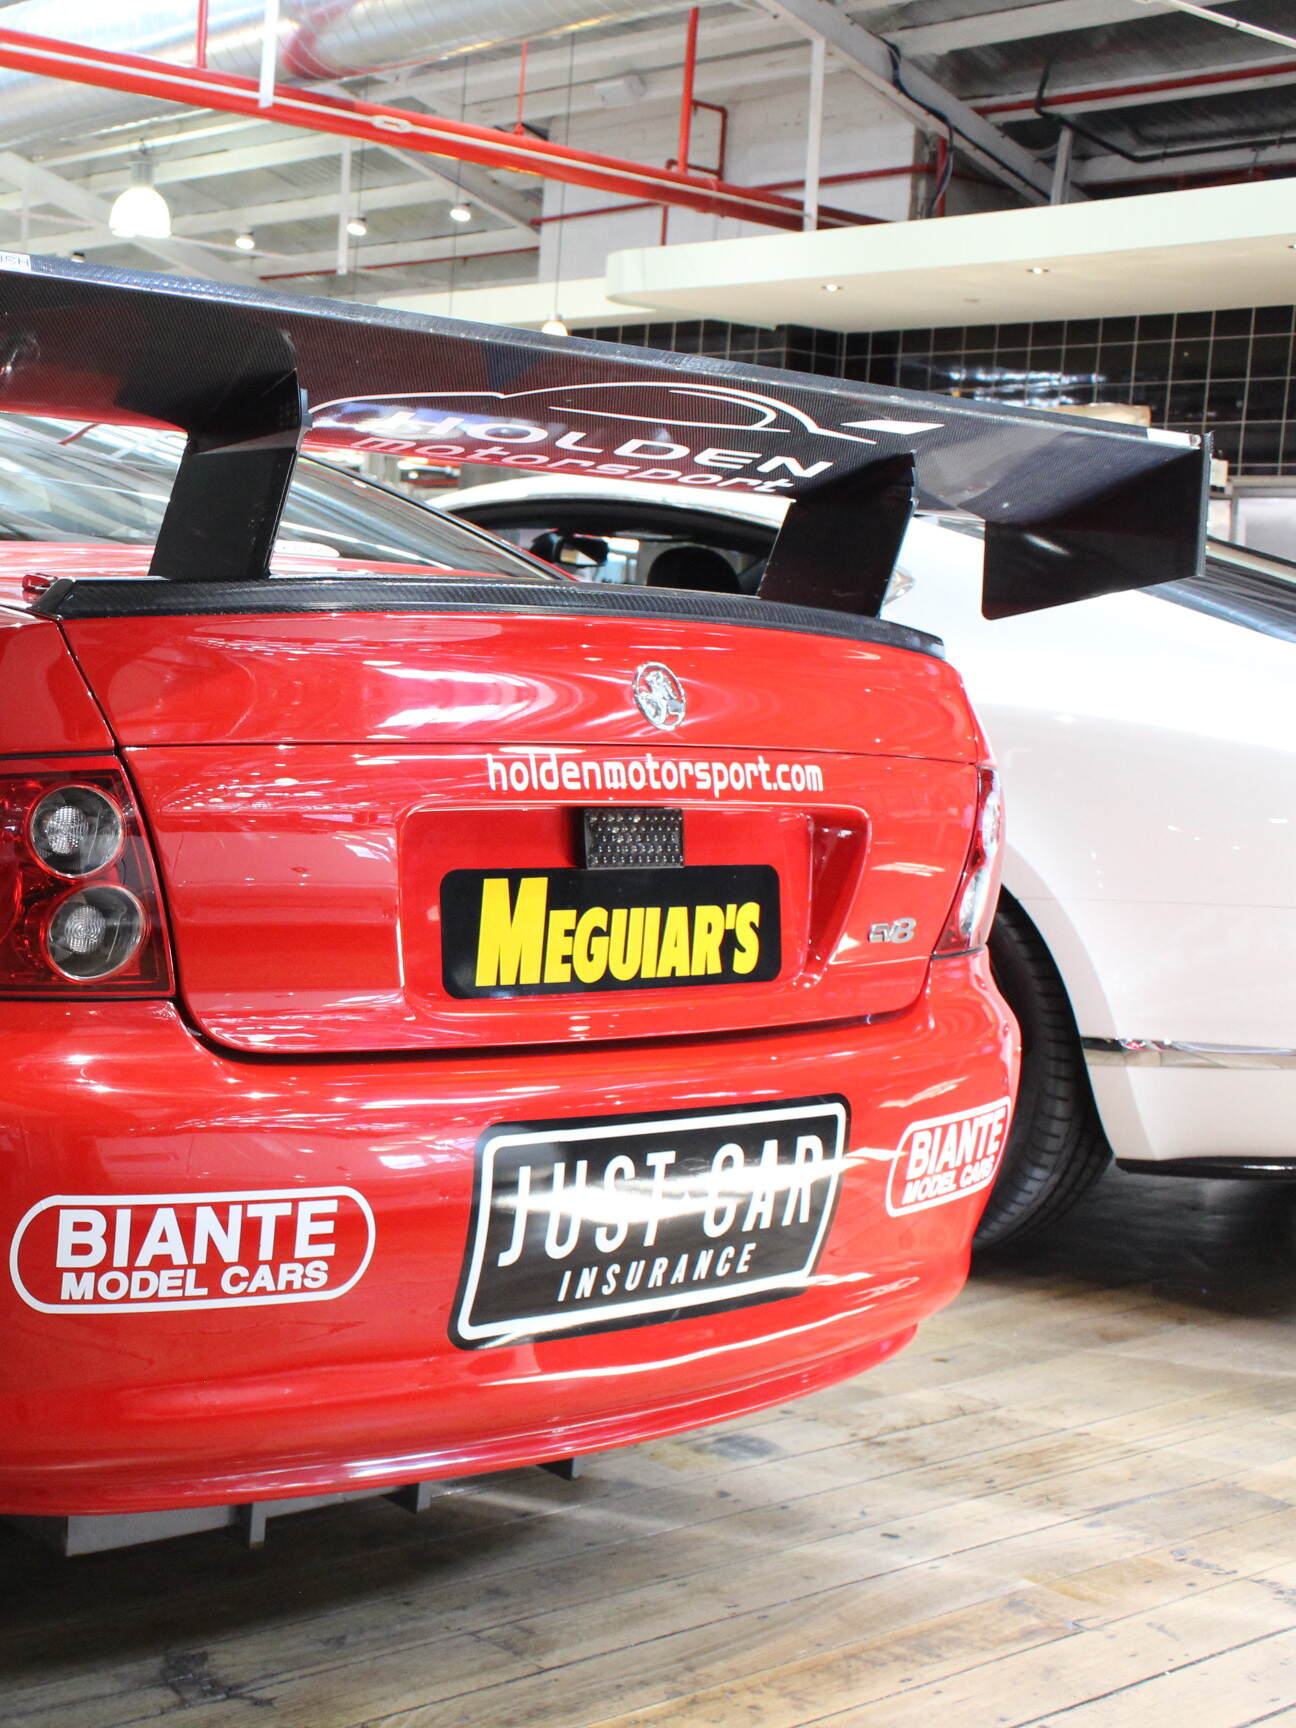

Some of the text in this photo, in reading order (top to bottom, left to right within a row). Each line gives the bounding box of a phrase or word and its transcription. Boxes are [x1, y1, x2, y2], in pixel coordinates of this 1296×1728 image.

[351, 437, 797, 494] motorsport
[390, 411, 833, 479] HOLDEN
[486, 752, 824, 797] holdenmotorsport.com
[906, 1108, 1007, 1179] BIANTE
[498, 1134, 828, 1269] JUST CAR
[902, 1155, 996, 1206] MODEL CARS
[56, 1198, 338, 1268] BIANTE
[60, 1259, 329, 1301] MODEL CARS
[557, 1242, 758, 1303] INSURANCE
